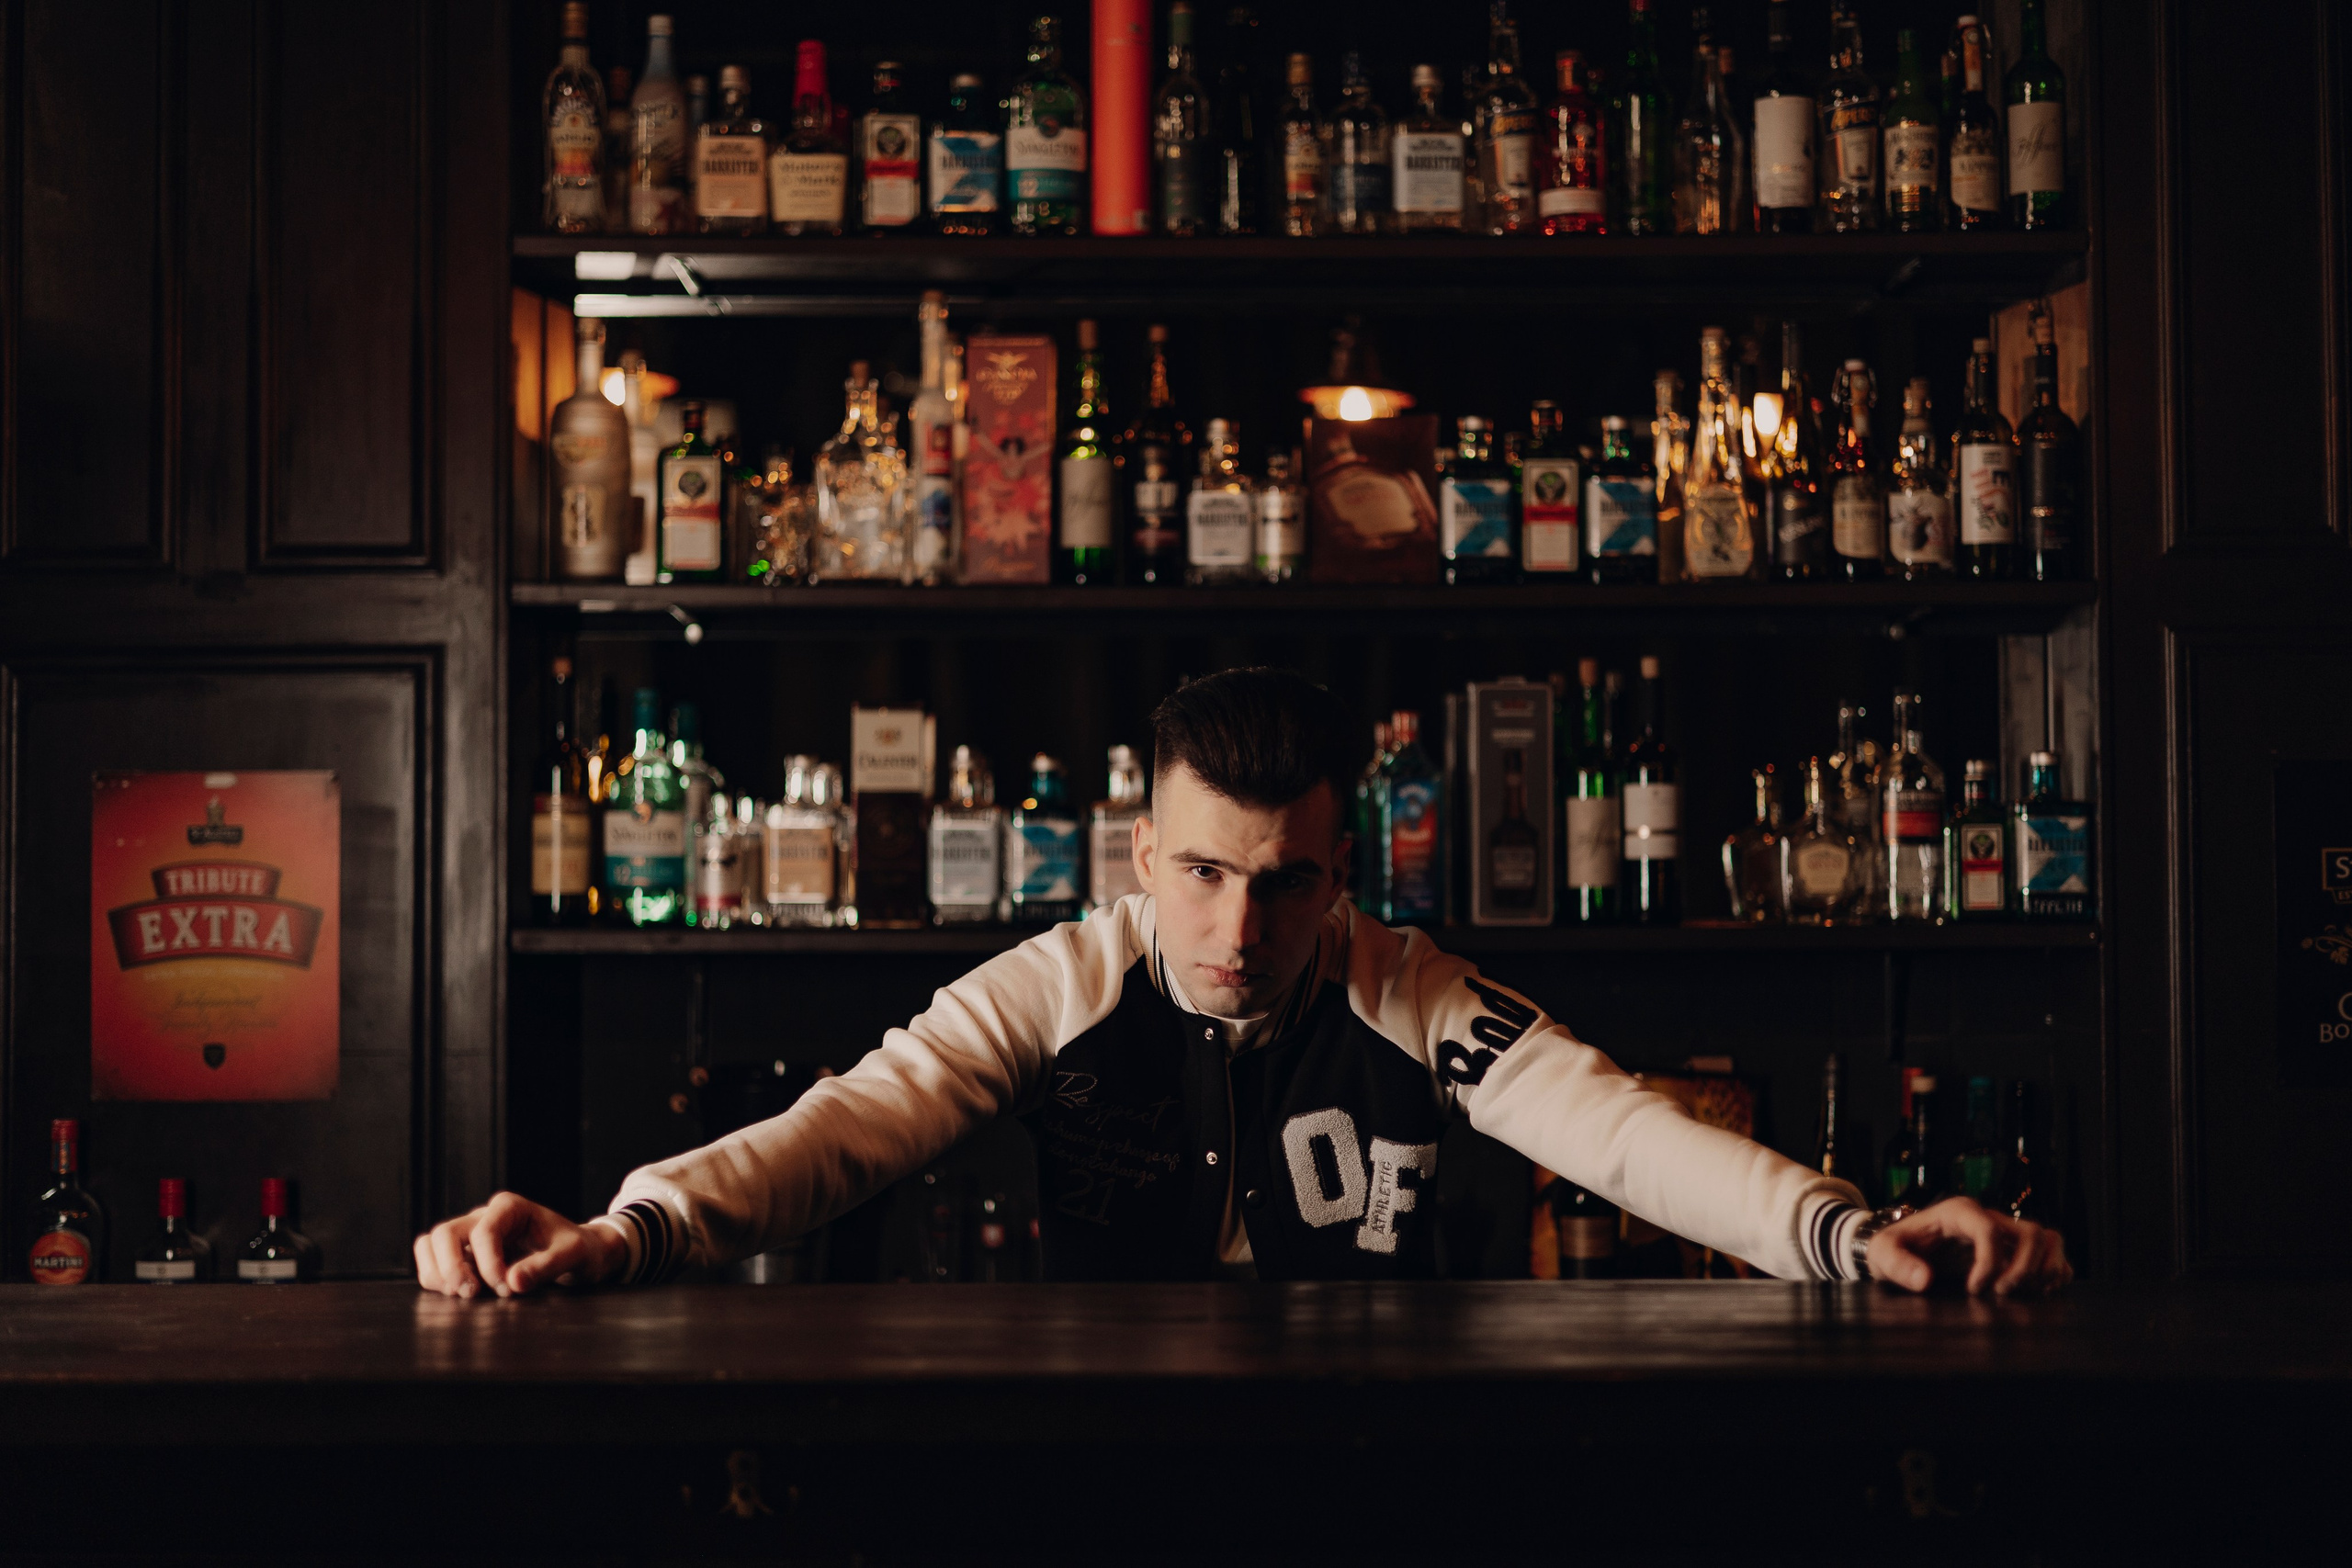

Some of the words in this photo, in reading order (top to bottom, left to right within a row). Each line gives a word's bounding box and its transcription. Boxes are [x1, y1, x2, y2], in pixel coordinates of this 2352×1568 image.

[164, 868, 266, 896] TRIBUTE
[138, 905, 293, 954] EXTRA
[1050, 1070, 1182, 1132] Respect
[1371, 1160, 1393, 1235] ATHLETIC
[33, 1256, 84, 1269] MARTINI
